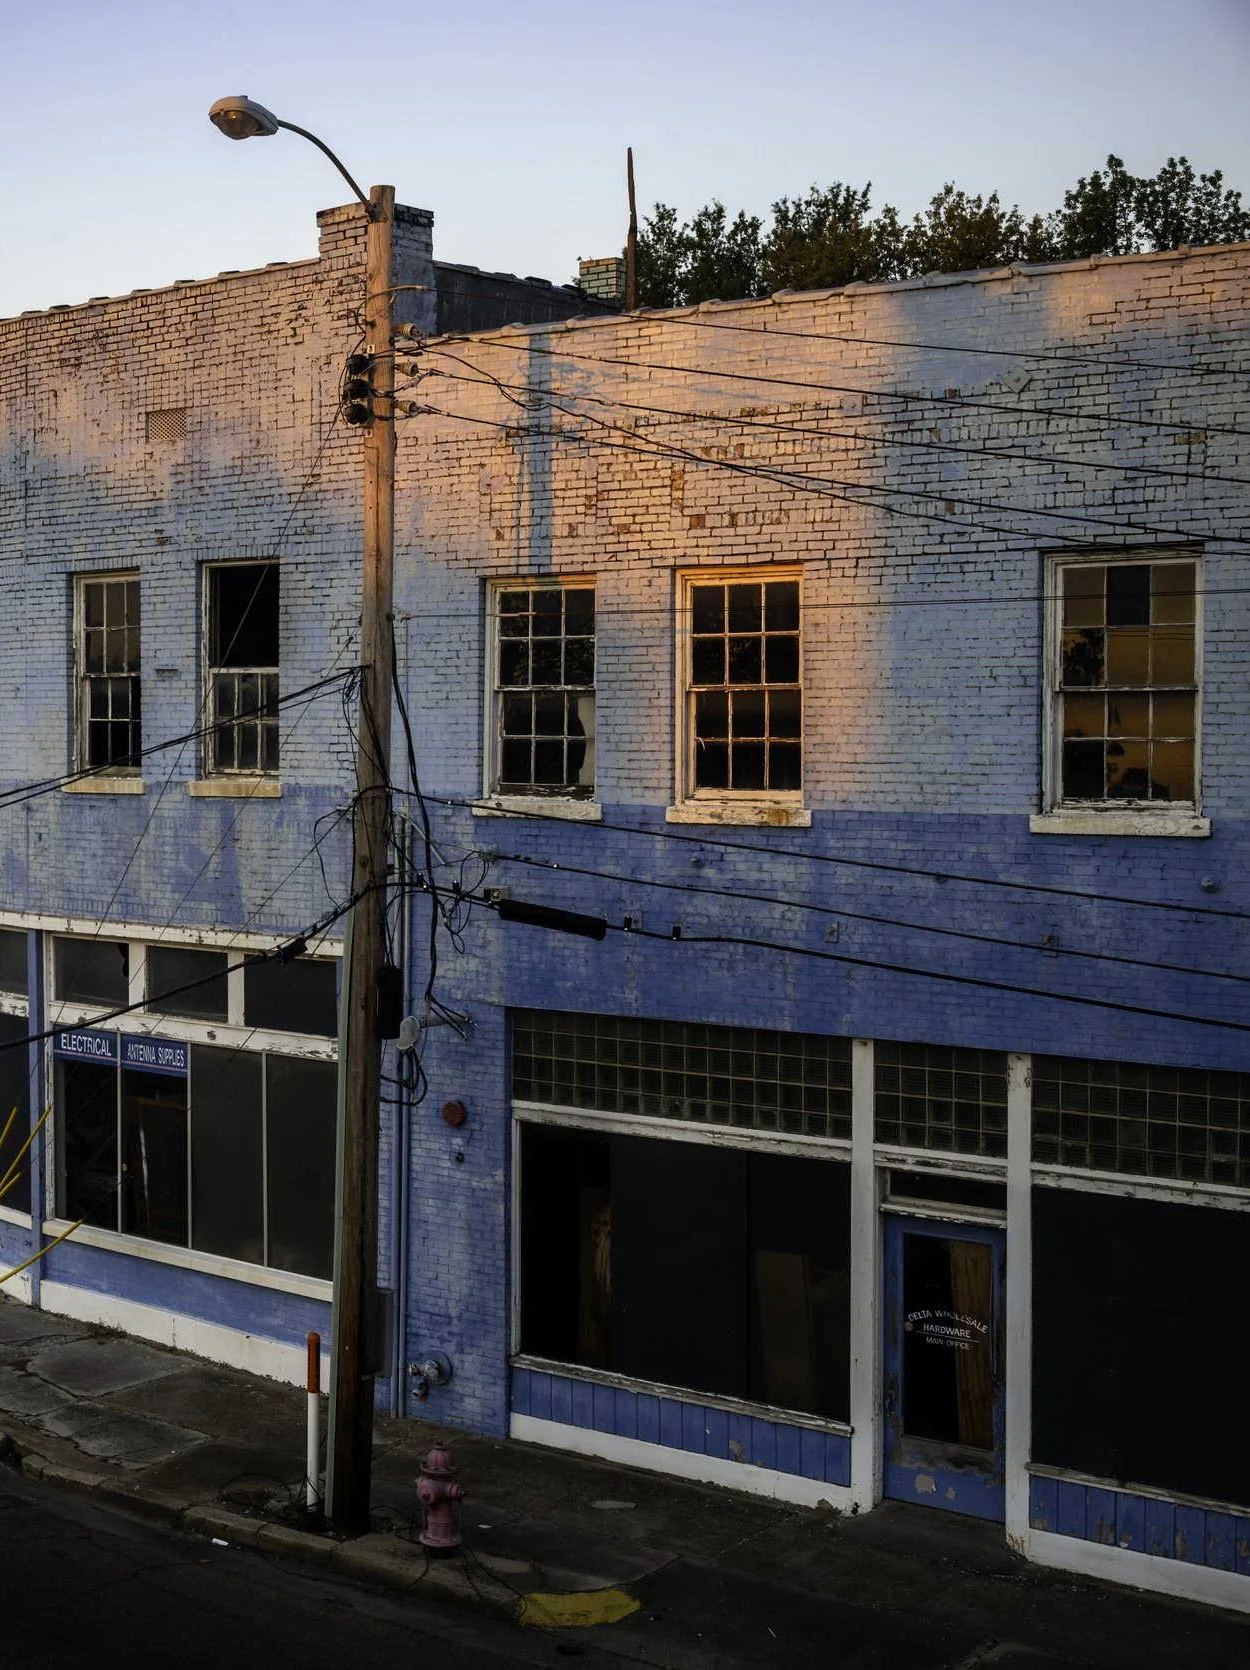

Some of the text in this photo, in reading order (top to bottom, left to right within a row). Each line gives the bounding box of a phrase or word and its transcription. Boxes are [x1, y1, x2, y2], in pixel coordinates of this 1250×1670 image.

[61, 1033, 112, 1057] ELECTRICAL
[127, 1043, 185, 1067] ANTENNA SUPPLIES
[908, 1310, 989, 1334] DELTA WHOLESALE
[923, 1322, 971, 1338] HARDWARE
[926, 1337, 970, 1350] MAIN OFFICE
